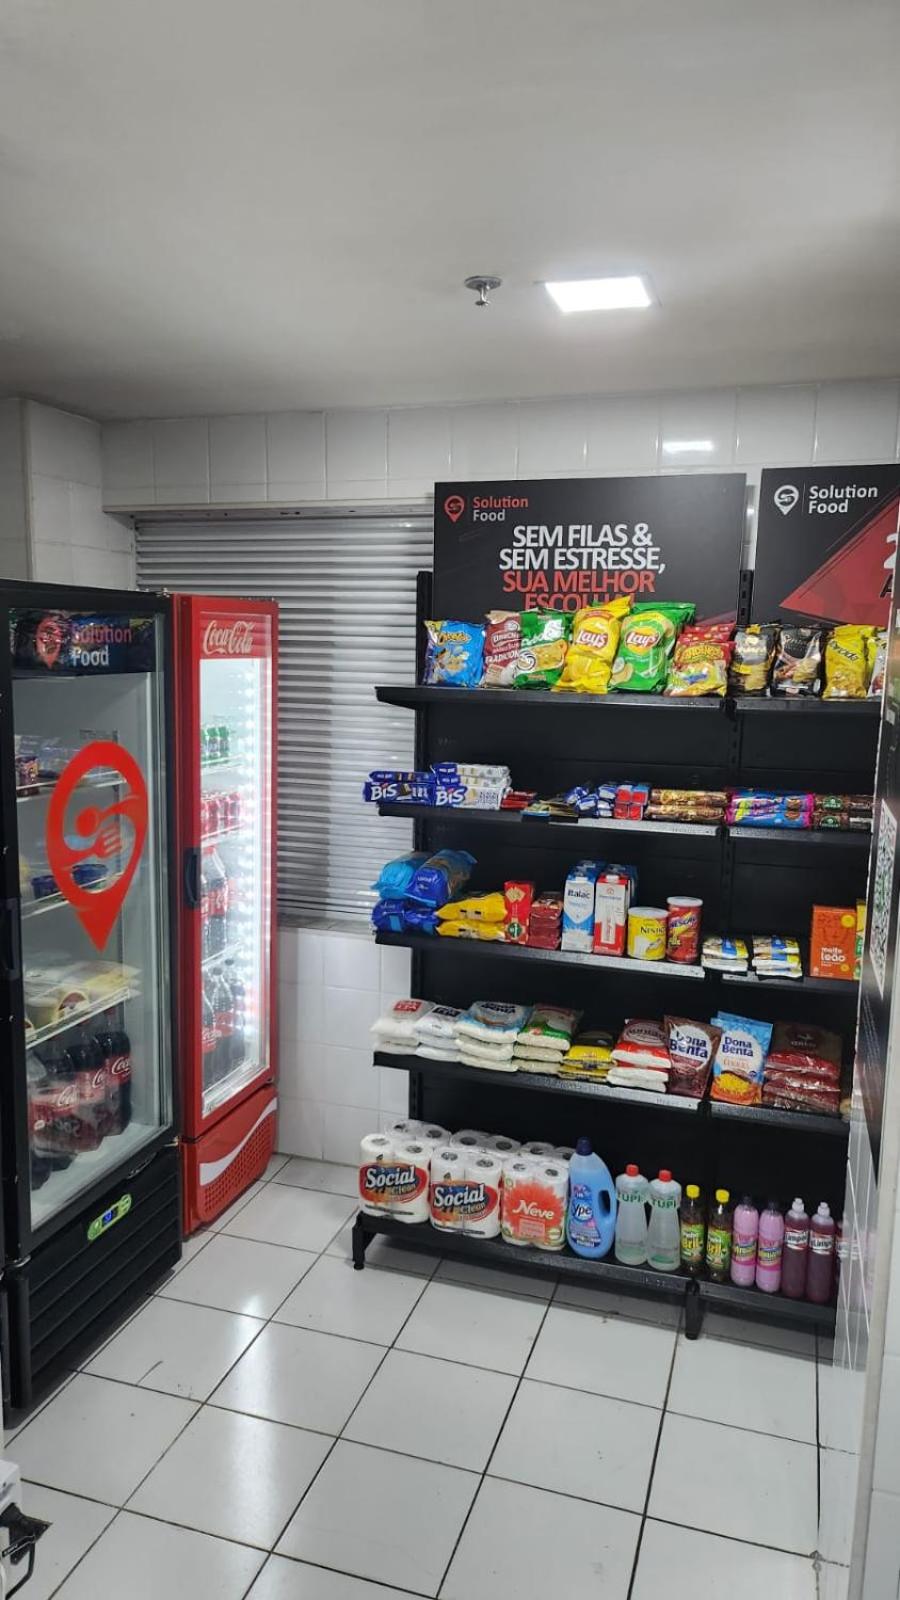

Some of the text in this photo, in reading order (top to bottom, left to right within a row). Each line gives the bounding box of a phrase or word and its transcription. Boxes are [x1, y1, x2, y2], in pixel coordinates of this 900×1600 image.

[472, 495, 529, 508] Solution
[809, 484, 879, 499] Solution
[472, 509, 506, 522] Food
[808, 499, 849, 514] Food
[513, 522, 653, 547] SEM FILAS &
[499, 547, 666, 574] SEM ESTRESSE,
[502, 570, 656, 593] SUA MELHOR
[71, 623, 133, 643] Solution
[70, 645, 110, 666] Food
[721, 1045, 754, 1058] Benta
[724, 1035, 752, 1049] Dona
[365, 1165, 416, 1189] Social
[434, 1183, 486, 1207] Social
[512, 1199, 555, 1220] Neve
